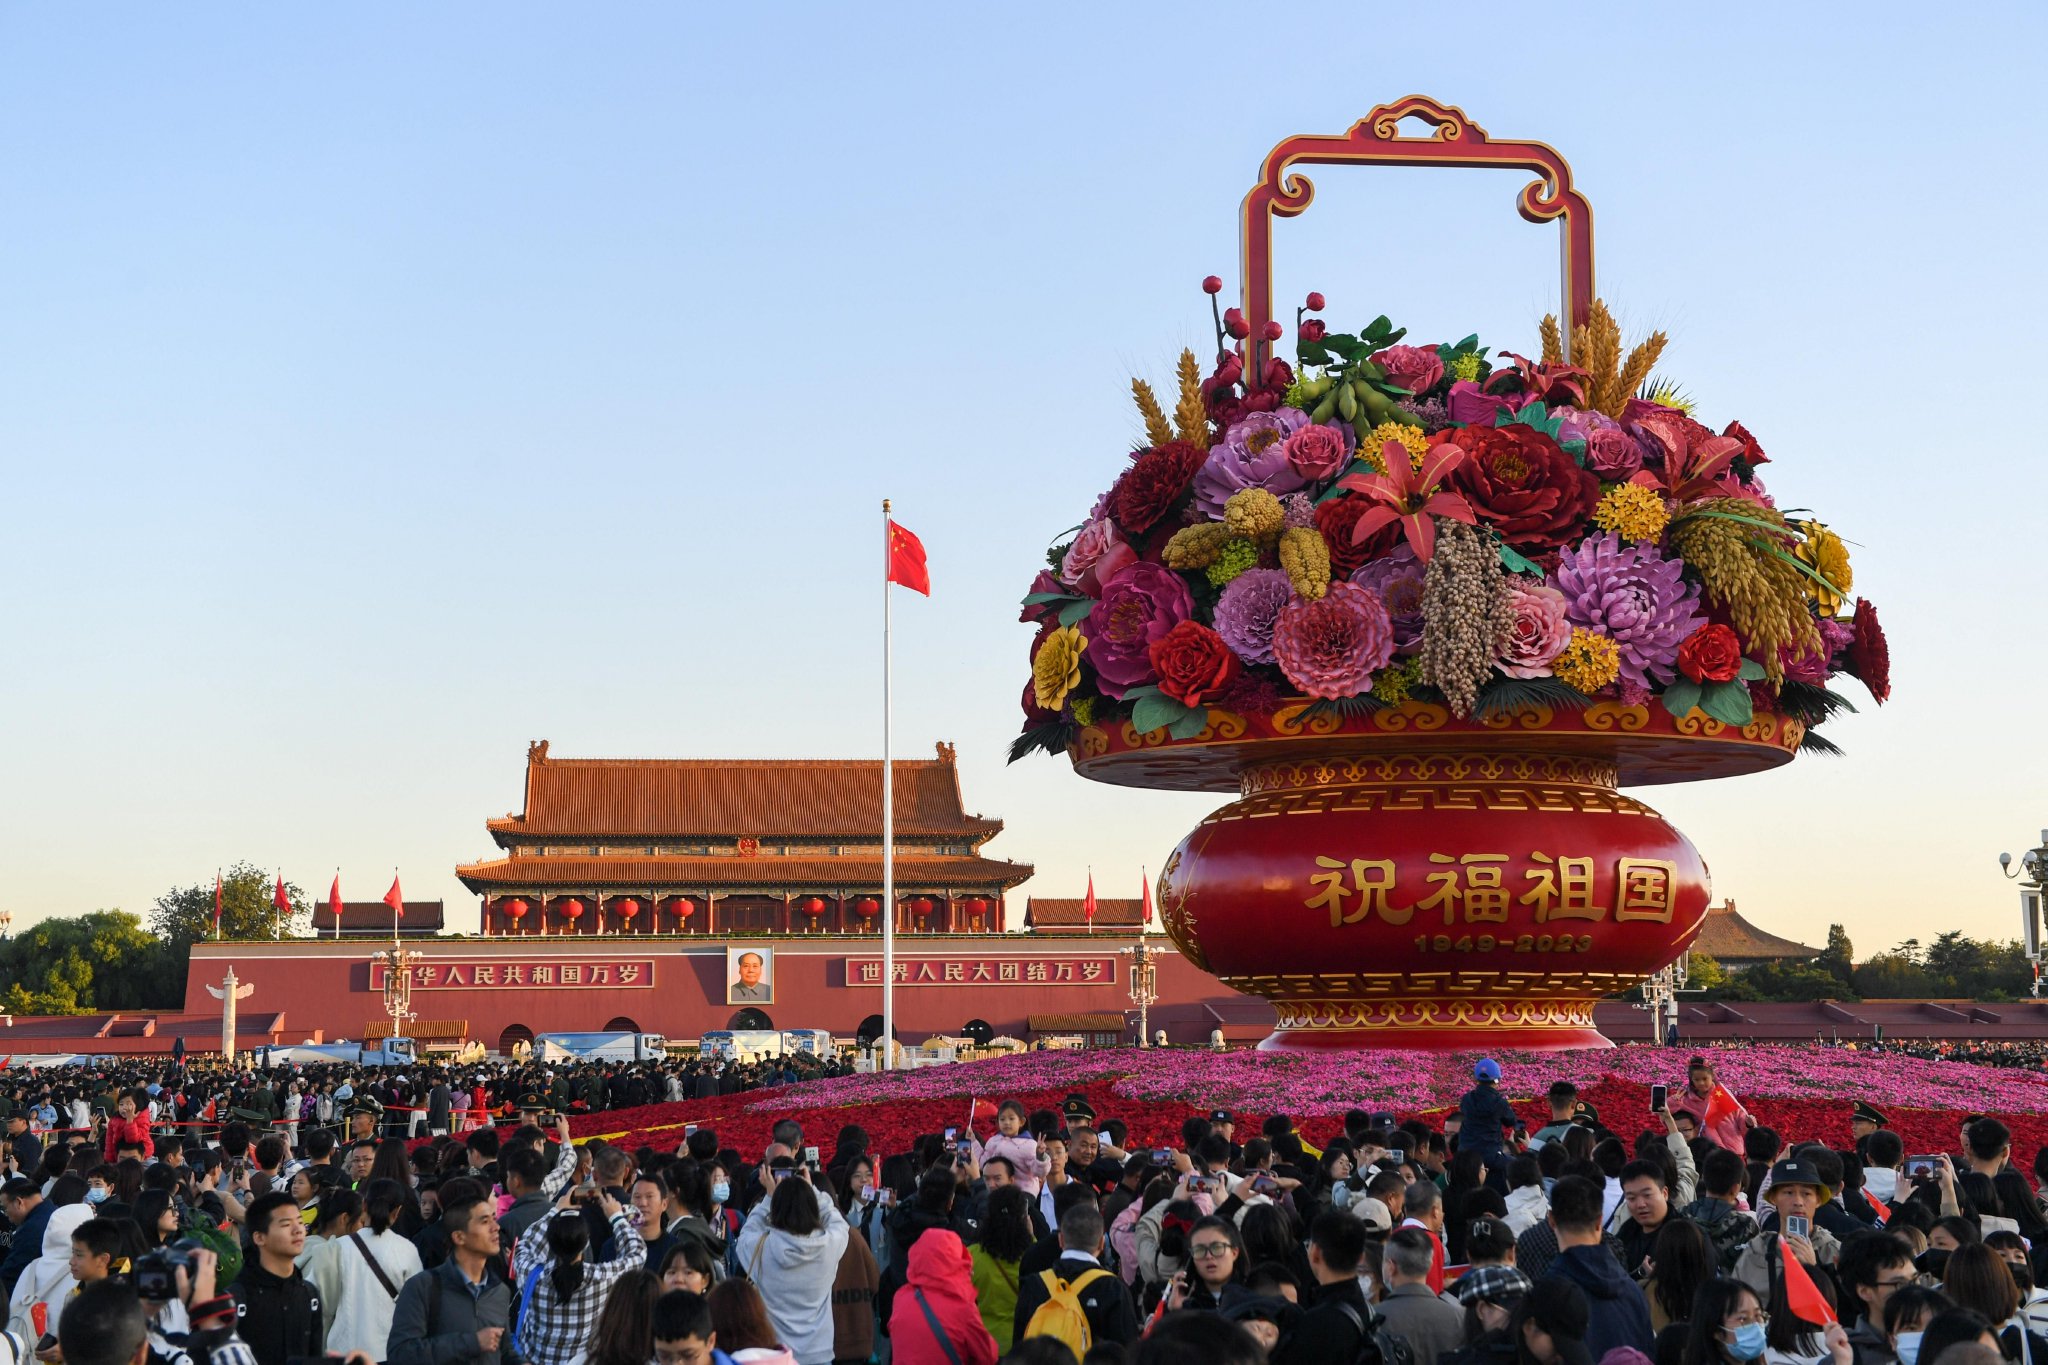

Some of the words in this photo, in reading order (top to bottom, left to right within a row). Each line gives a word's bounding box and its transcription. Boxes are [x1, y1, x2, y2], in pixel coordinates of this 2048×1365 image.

[1304, 851, 1679, 928] 祝福祖国
[1414, 934, 1592, 952] 1949-2023
[386, 964, 639, 985] 华人民共和国万岁
[861, 962, 1102, 982] 世界人民大团结万岁
